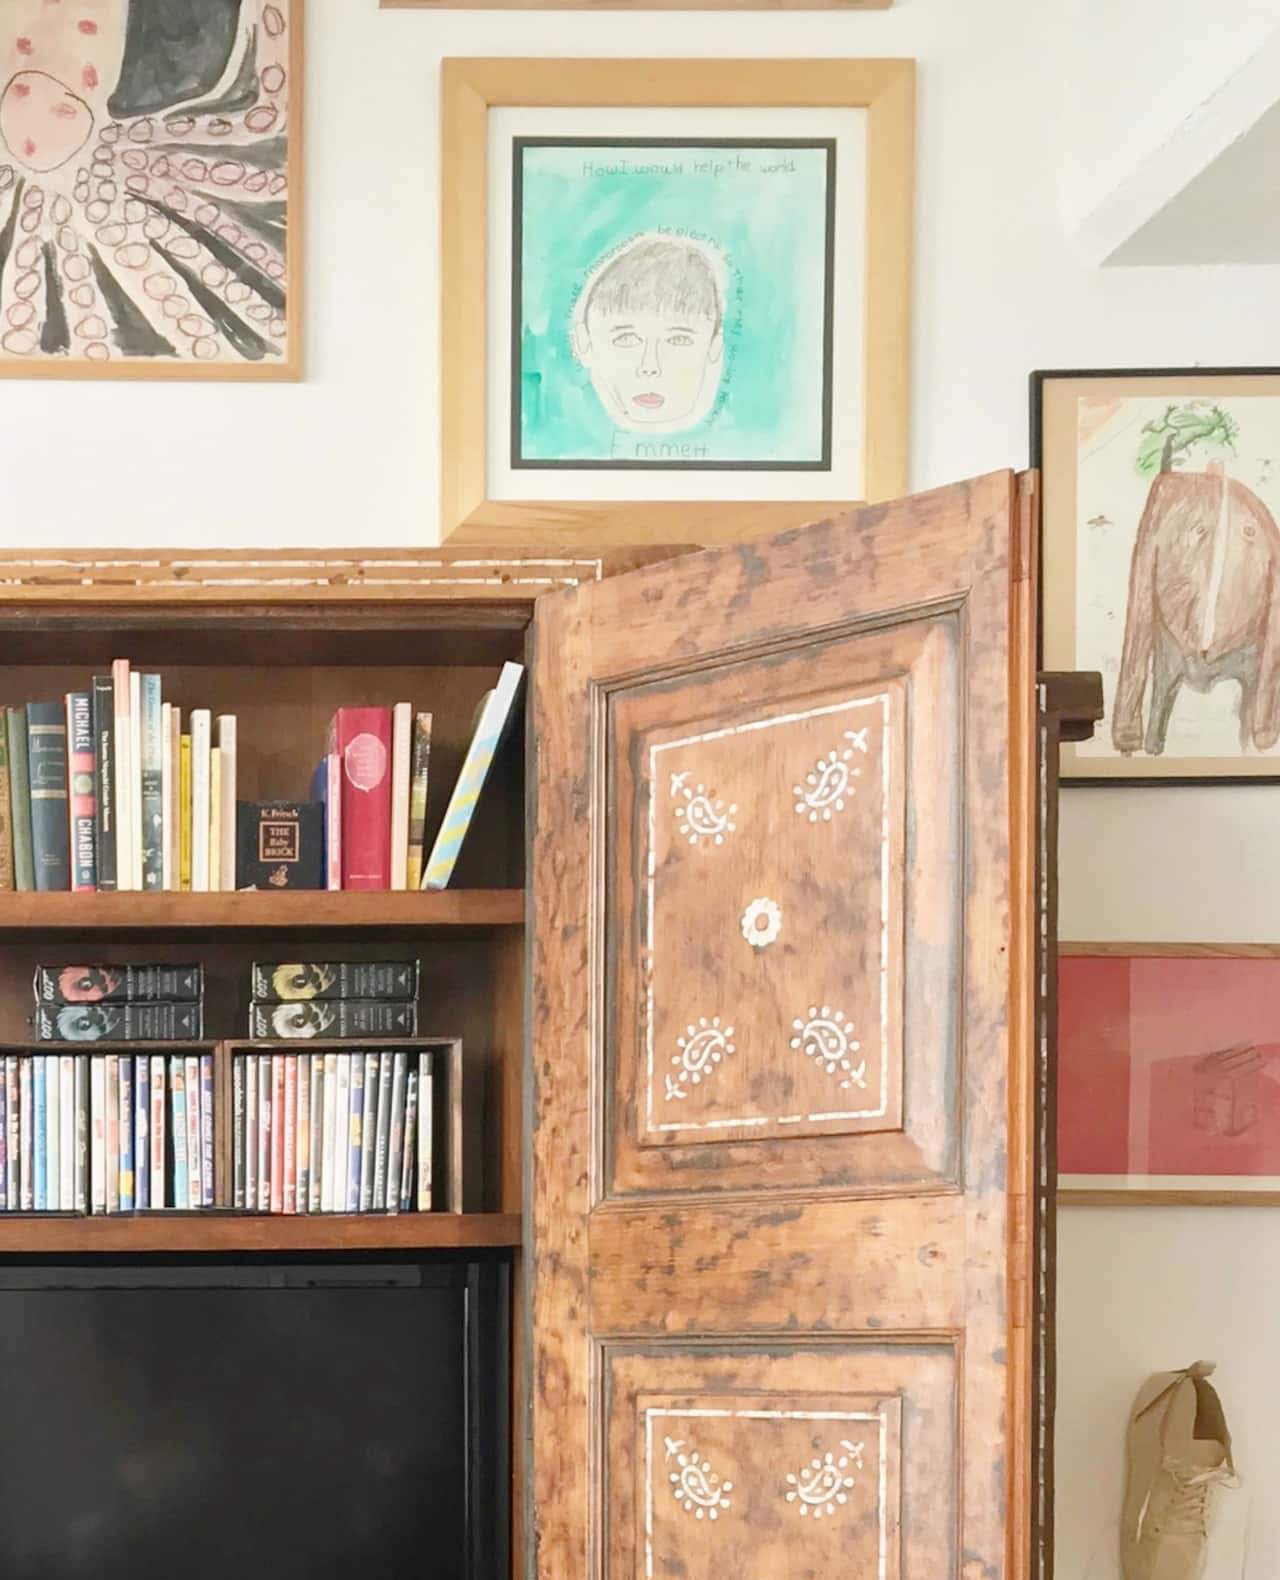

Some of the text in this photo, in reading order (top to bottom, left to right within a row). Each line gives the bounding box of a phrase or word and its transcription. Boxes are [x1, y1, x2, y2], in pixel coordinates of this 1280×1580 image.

[693, 158, 724, 178] help
[74, 698, 90, 750] MICHAEL
[78, 818, 93, 869] CHABON
[270, 828, 290, 837] THE
[42, 969, 55, 1000] 007
[256, 967, 268, 998] 007
[40, 1008, 53, 1039] 007
[256, 1007, 268, 1037] 007
